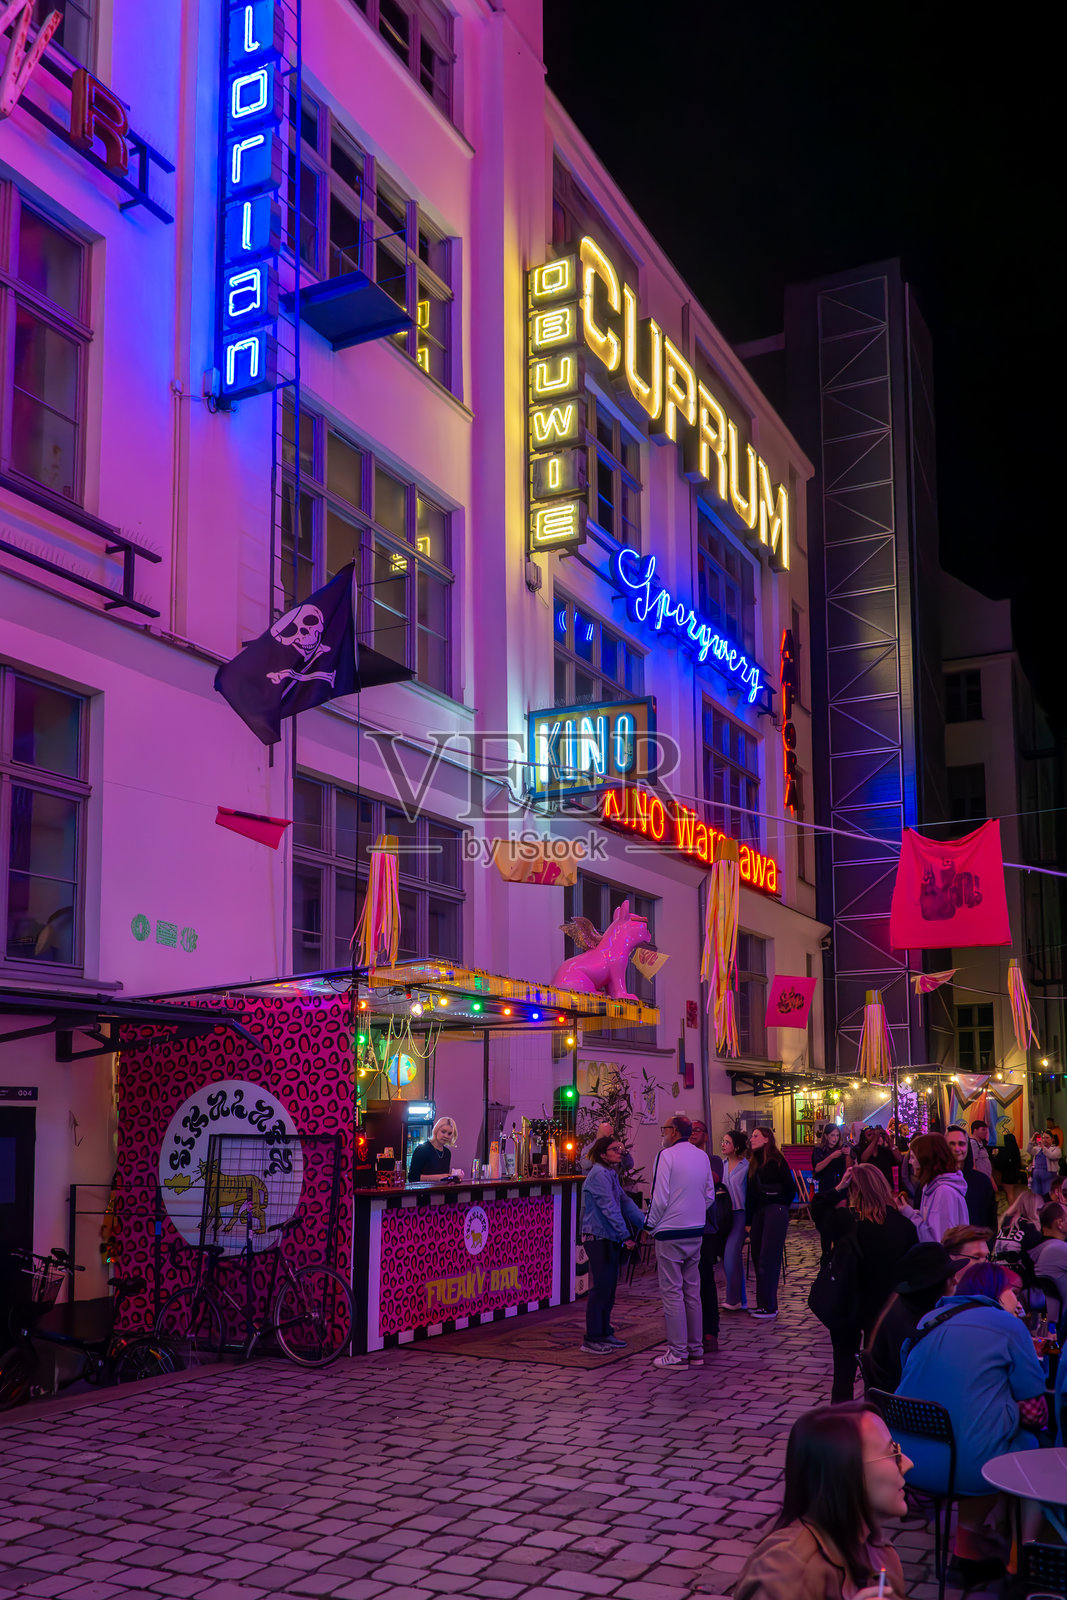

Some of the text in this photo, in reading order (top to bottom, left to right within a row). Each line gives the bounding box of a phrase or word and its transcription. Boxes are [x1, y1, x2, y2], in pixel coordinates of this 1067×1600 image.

[531, 259, 575, 541] OBUWIE
[580, 235, 790, 573] CUPRUM
[539, 712, 632, 785] KINO
[604, 789, 778, 893] KINO Warawa
[425, 1266, 522, 1309] FREAKY BAR
